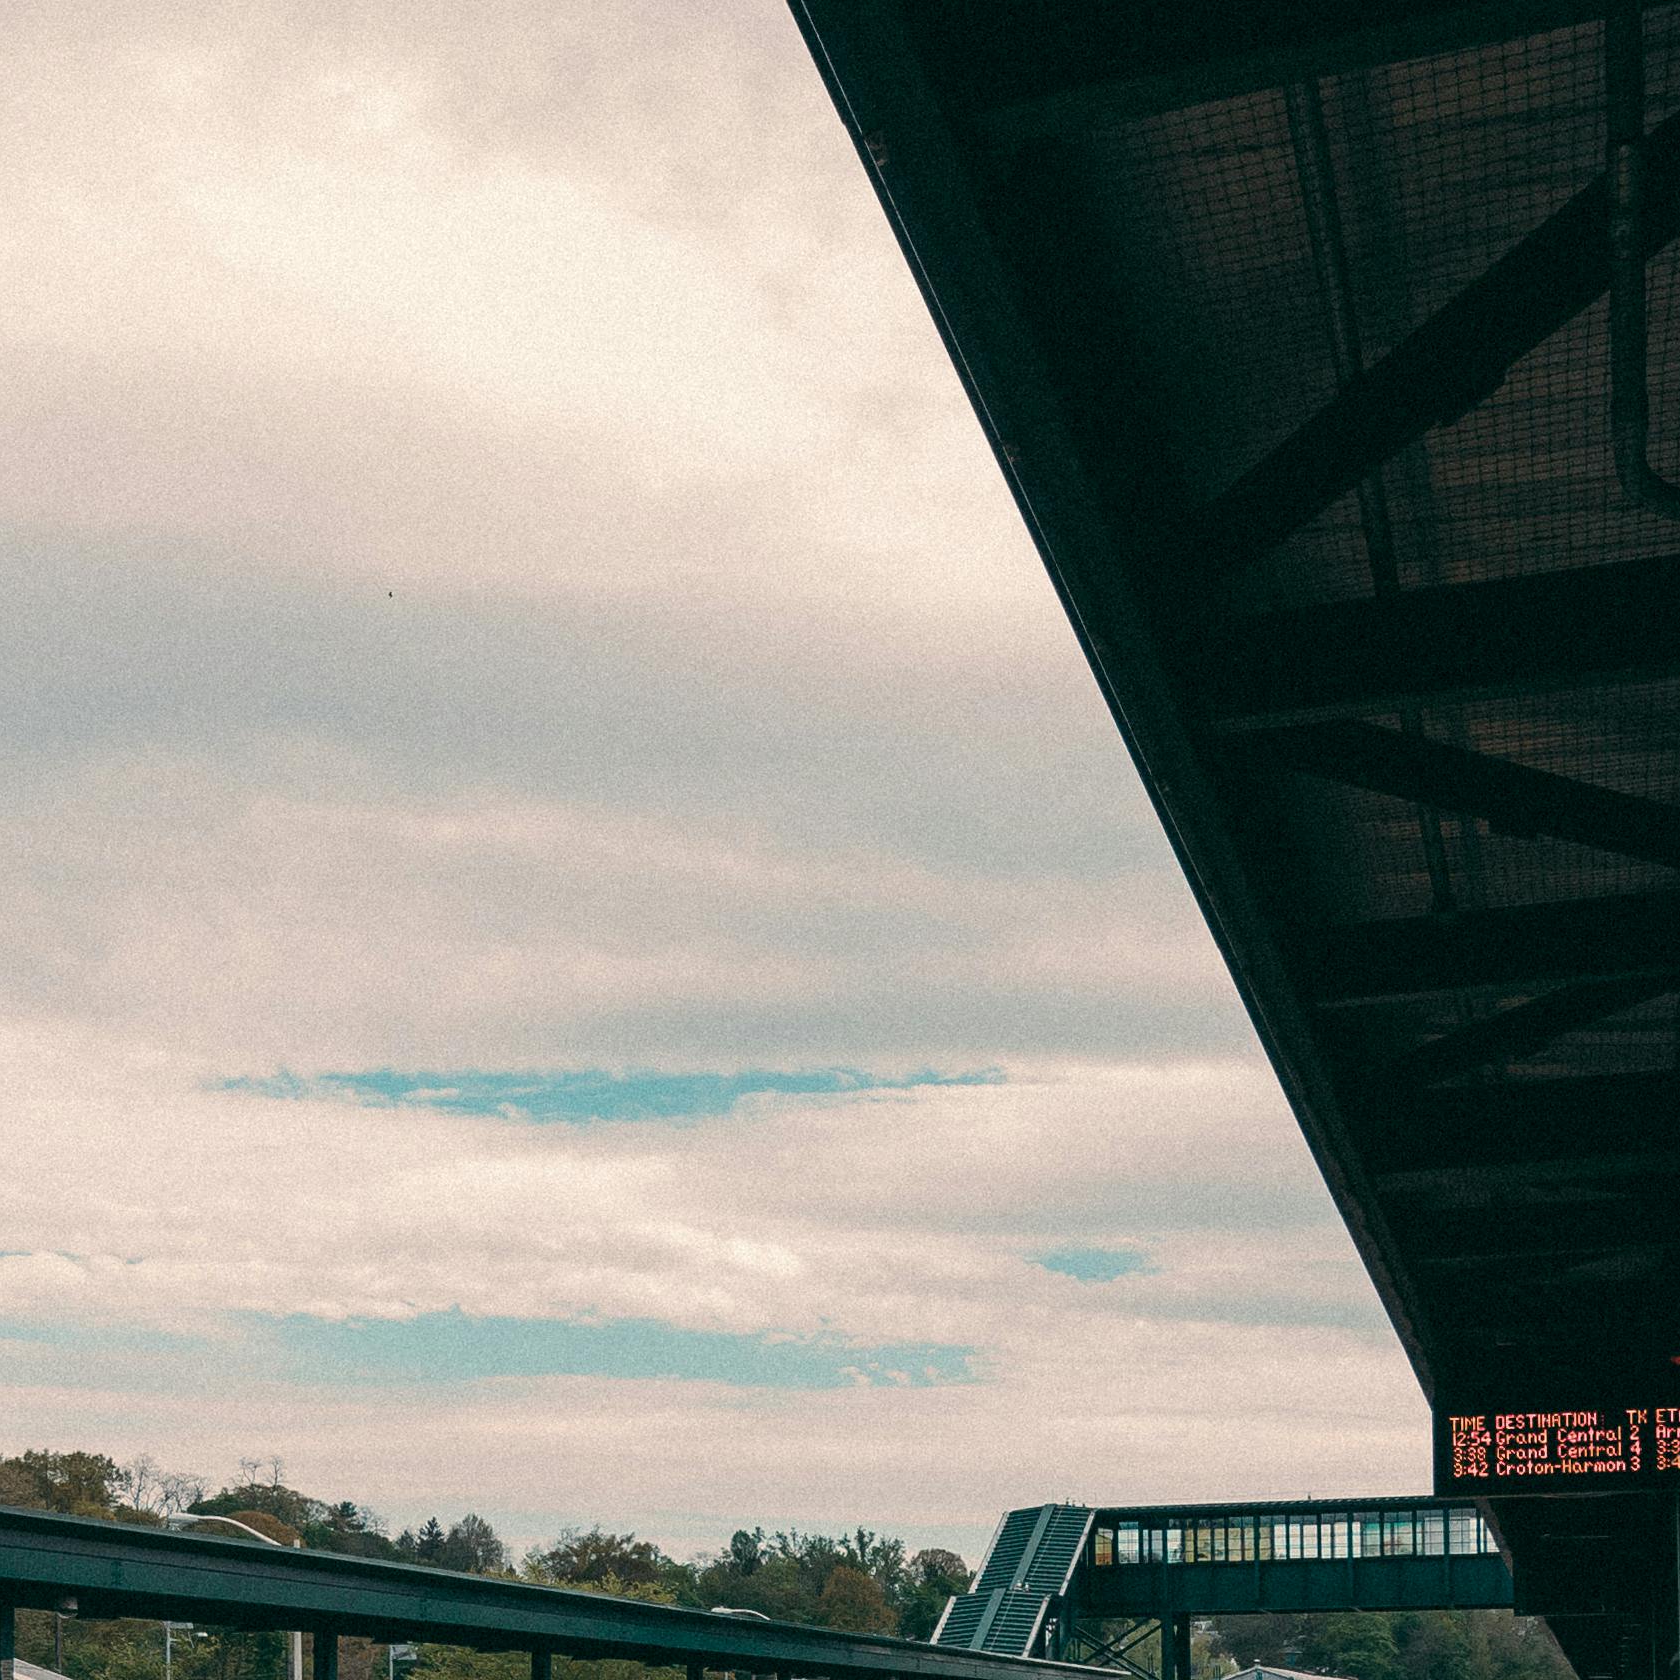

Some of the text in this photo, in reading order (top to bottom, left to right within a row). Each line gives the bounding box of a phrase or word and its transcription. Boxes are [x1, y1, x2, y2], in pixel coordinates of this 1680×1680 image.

[1449, 1415, 1487, 1431] TIME
[1495, 1411, 1598, 1430] DESTINATION
[1626, 1408, 1648, 1425] TK
[1452, 1431, 1492, 1447] 12:54
[1495, 1429, 1548, 1445] Grand
[1557, 1425, 1622, 1443] Central
[1629, 1425, 1641, 1440] 2
[1495, 1444, 1548, 1460] Grand
[1557, 1440, 1622, 1458] Central
[1630, 1440, 1642, 1456] 4
[1453, 1462, 1490, 1478] 3:42
[1495, 1458, 1627, 1476] Croton-Harmon
[1630, 1456, 1641, 1472] 3
